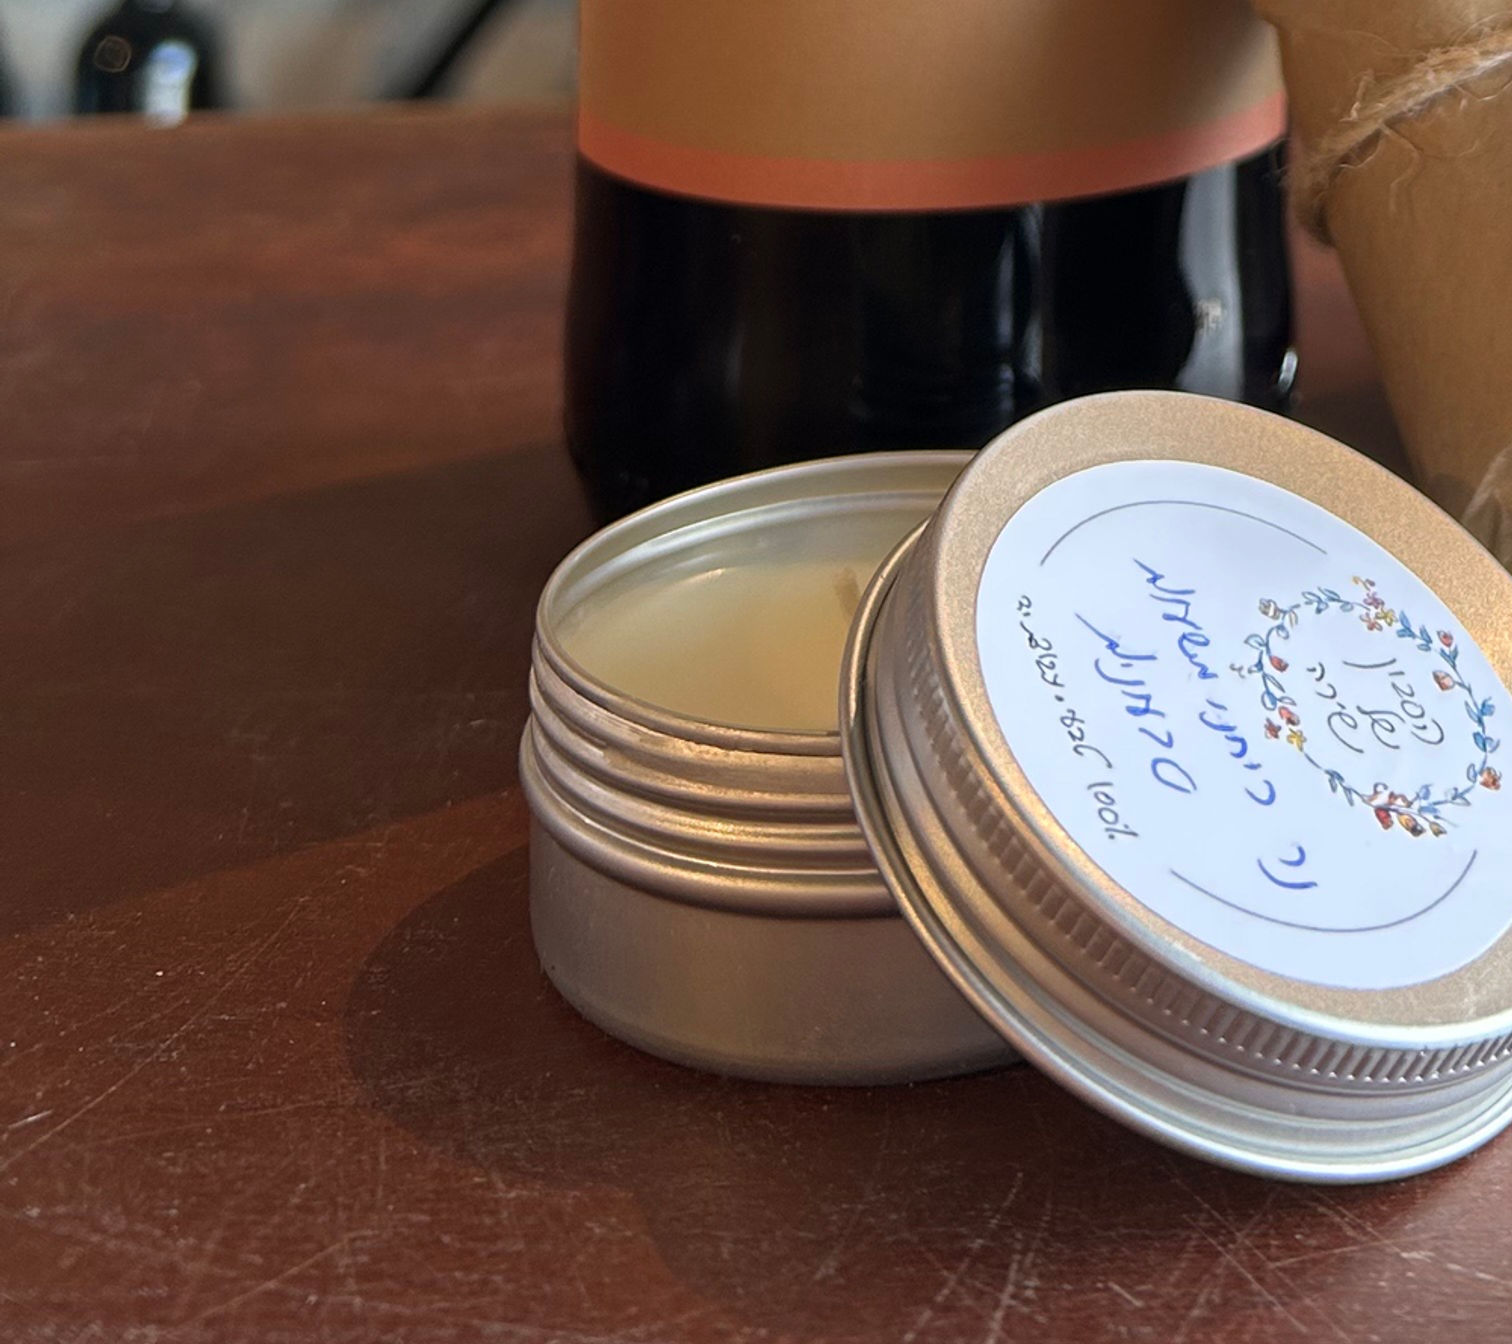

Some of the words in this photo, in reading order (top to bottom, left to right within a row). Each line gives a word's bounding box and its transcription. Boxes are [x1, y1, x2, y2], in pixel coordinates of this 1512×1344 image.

[1305, 661, 1365, 754] שירה
[1341, 657, 1445, 746] הסבון
[1355, 704, 1406, 750] של
[1086, 780, 1139, 840] 100%
[1256, 844, 1319, 890] נר
